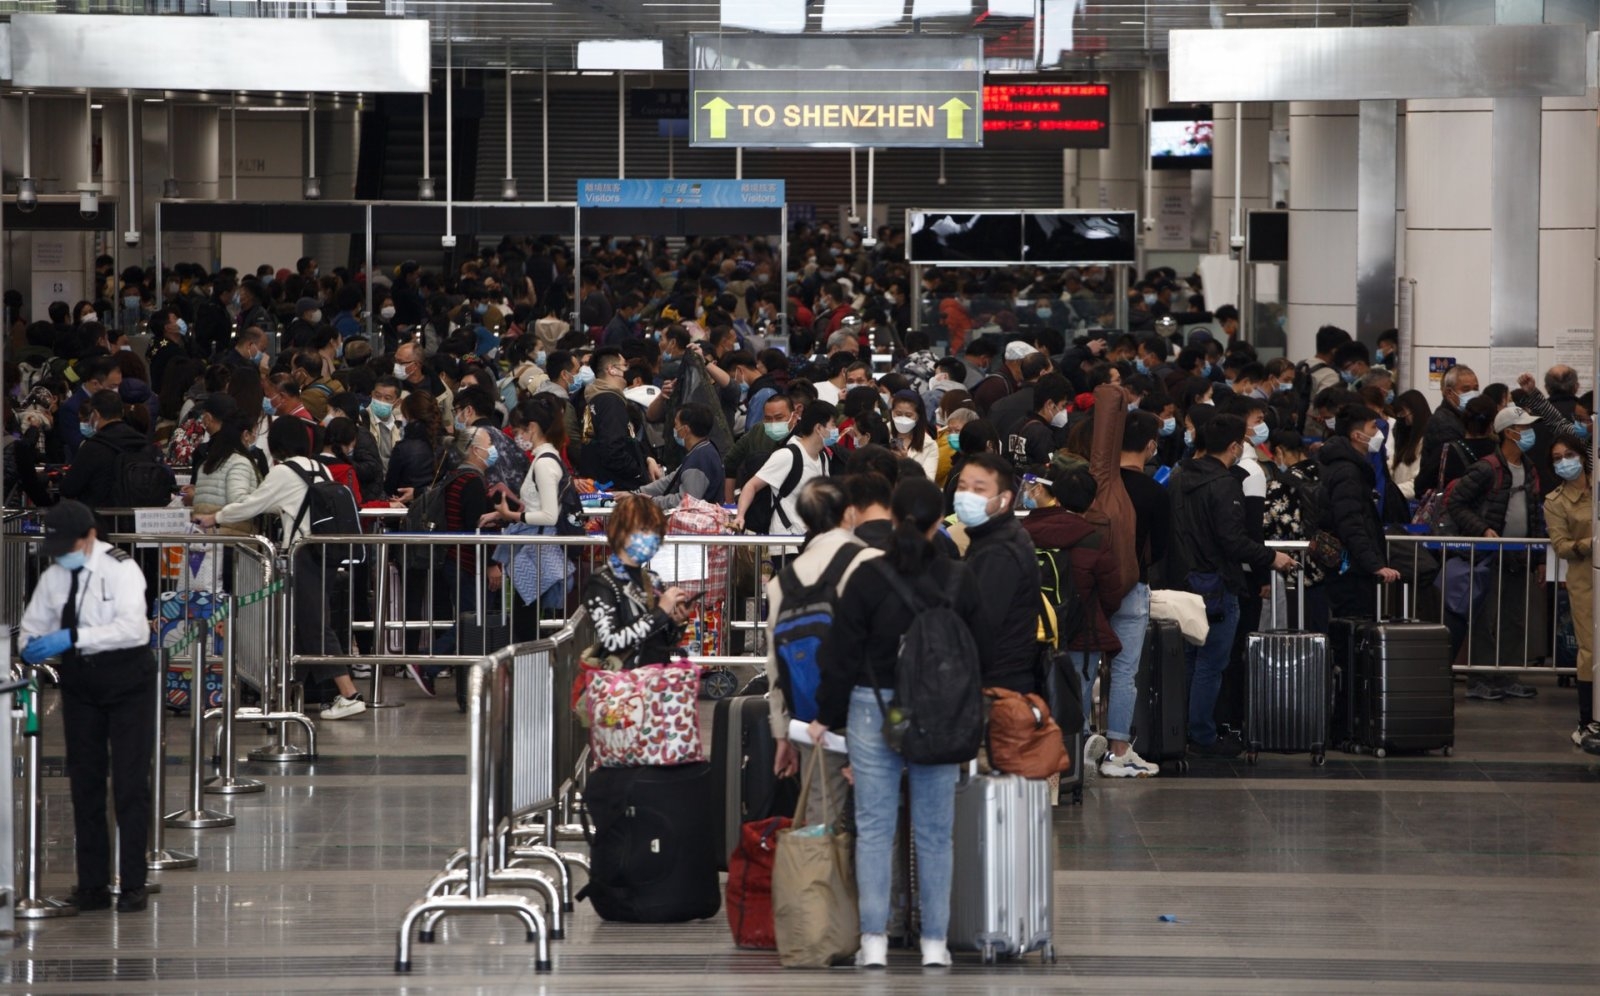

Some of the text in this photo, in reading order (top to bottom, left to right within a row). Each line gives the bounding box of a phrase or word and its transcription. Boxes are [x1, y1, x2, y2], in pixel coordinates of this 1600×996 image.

[738, 105, 934, 127] TO SHENZHEN
[585, 193, 620, 202] Visitors
[741, 193, 777, 202] Visitors
